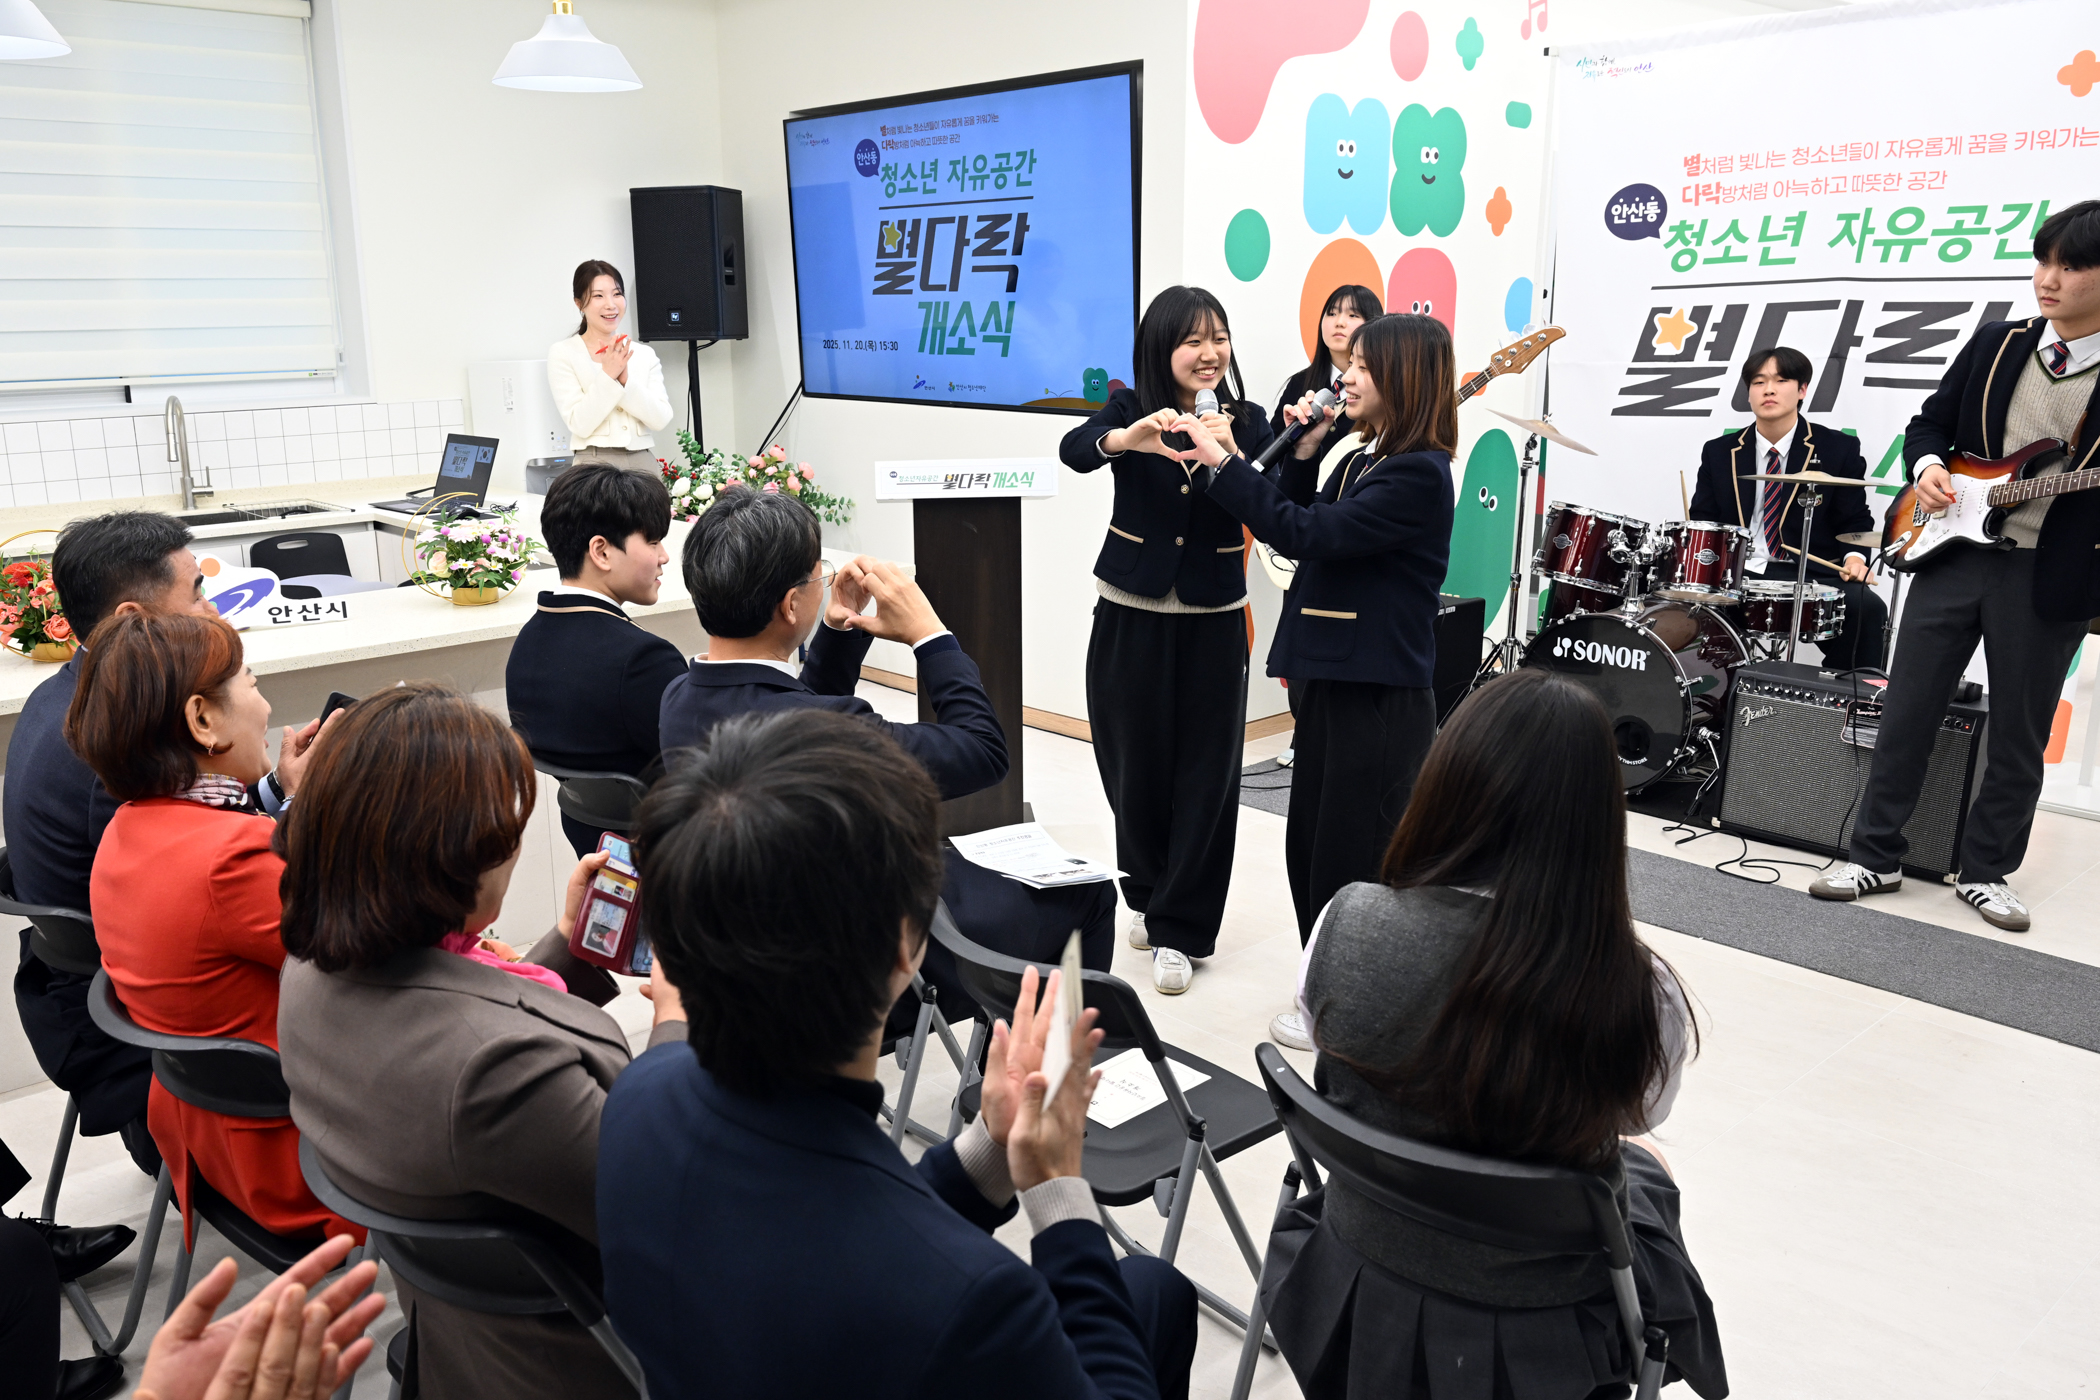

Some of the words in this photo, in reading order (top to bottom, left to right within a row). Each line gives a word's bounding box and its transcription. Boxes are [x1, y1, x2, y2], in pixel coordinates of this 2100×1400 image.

[856, 150, 878, 166] 안산동
[1683, 153, 1734, 177] 별처럼
[1739, 150, 1787, 173] 빛나는
[1791, 140, 1879, 166] 청소년들이
[1884, 135, 1963, 159] 자유롭게
[1968, 132, 2008, 155] 꿈을
[2014, 126, 2100, 151] 키워가는
[880, 158, 939, 199] 청소년
[947, 148, 1037, 192] 자유공간
[1682, 181, 1768, 206] 다락방처럼
[1773, 175, 1848, 199] 아늑하고
[1852, 172, 1902, 193] 따뜻한
[1907, 170, 1948, 191] 공간
[1611, 200, 1661, 224] 안산동
[1663, 210, 1807, 273] 청소년
[1827, 199, 2051, 264] 자유공간
[872, 212, 1030, 295] 별다락
[918, 300, 1016, 358] 개소식
[823, 340, 840, 350] 2025.
[843, 340, 853, 350] 11.
[879, 341, 899, 351] 15:30
[942, 473, 991, 490] 별다락
[993, 471, 1035, 488] 개소식
[268, 601, 348, 624] 안산시
[1573, 639, 1647, 671] SONOR
[1739, 705, 1776, 727] Fender
